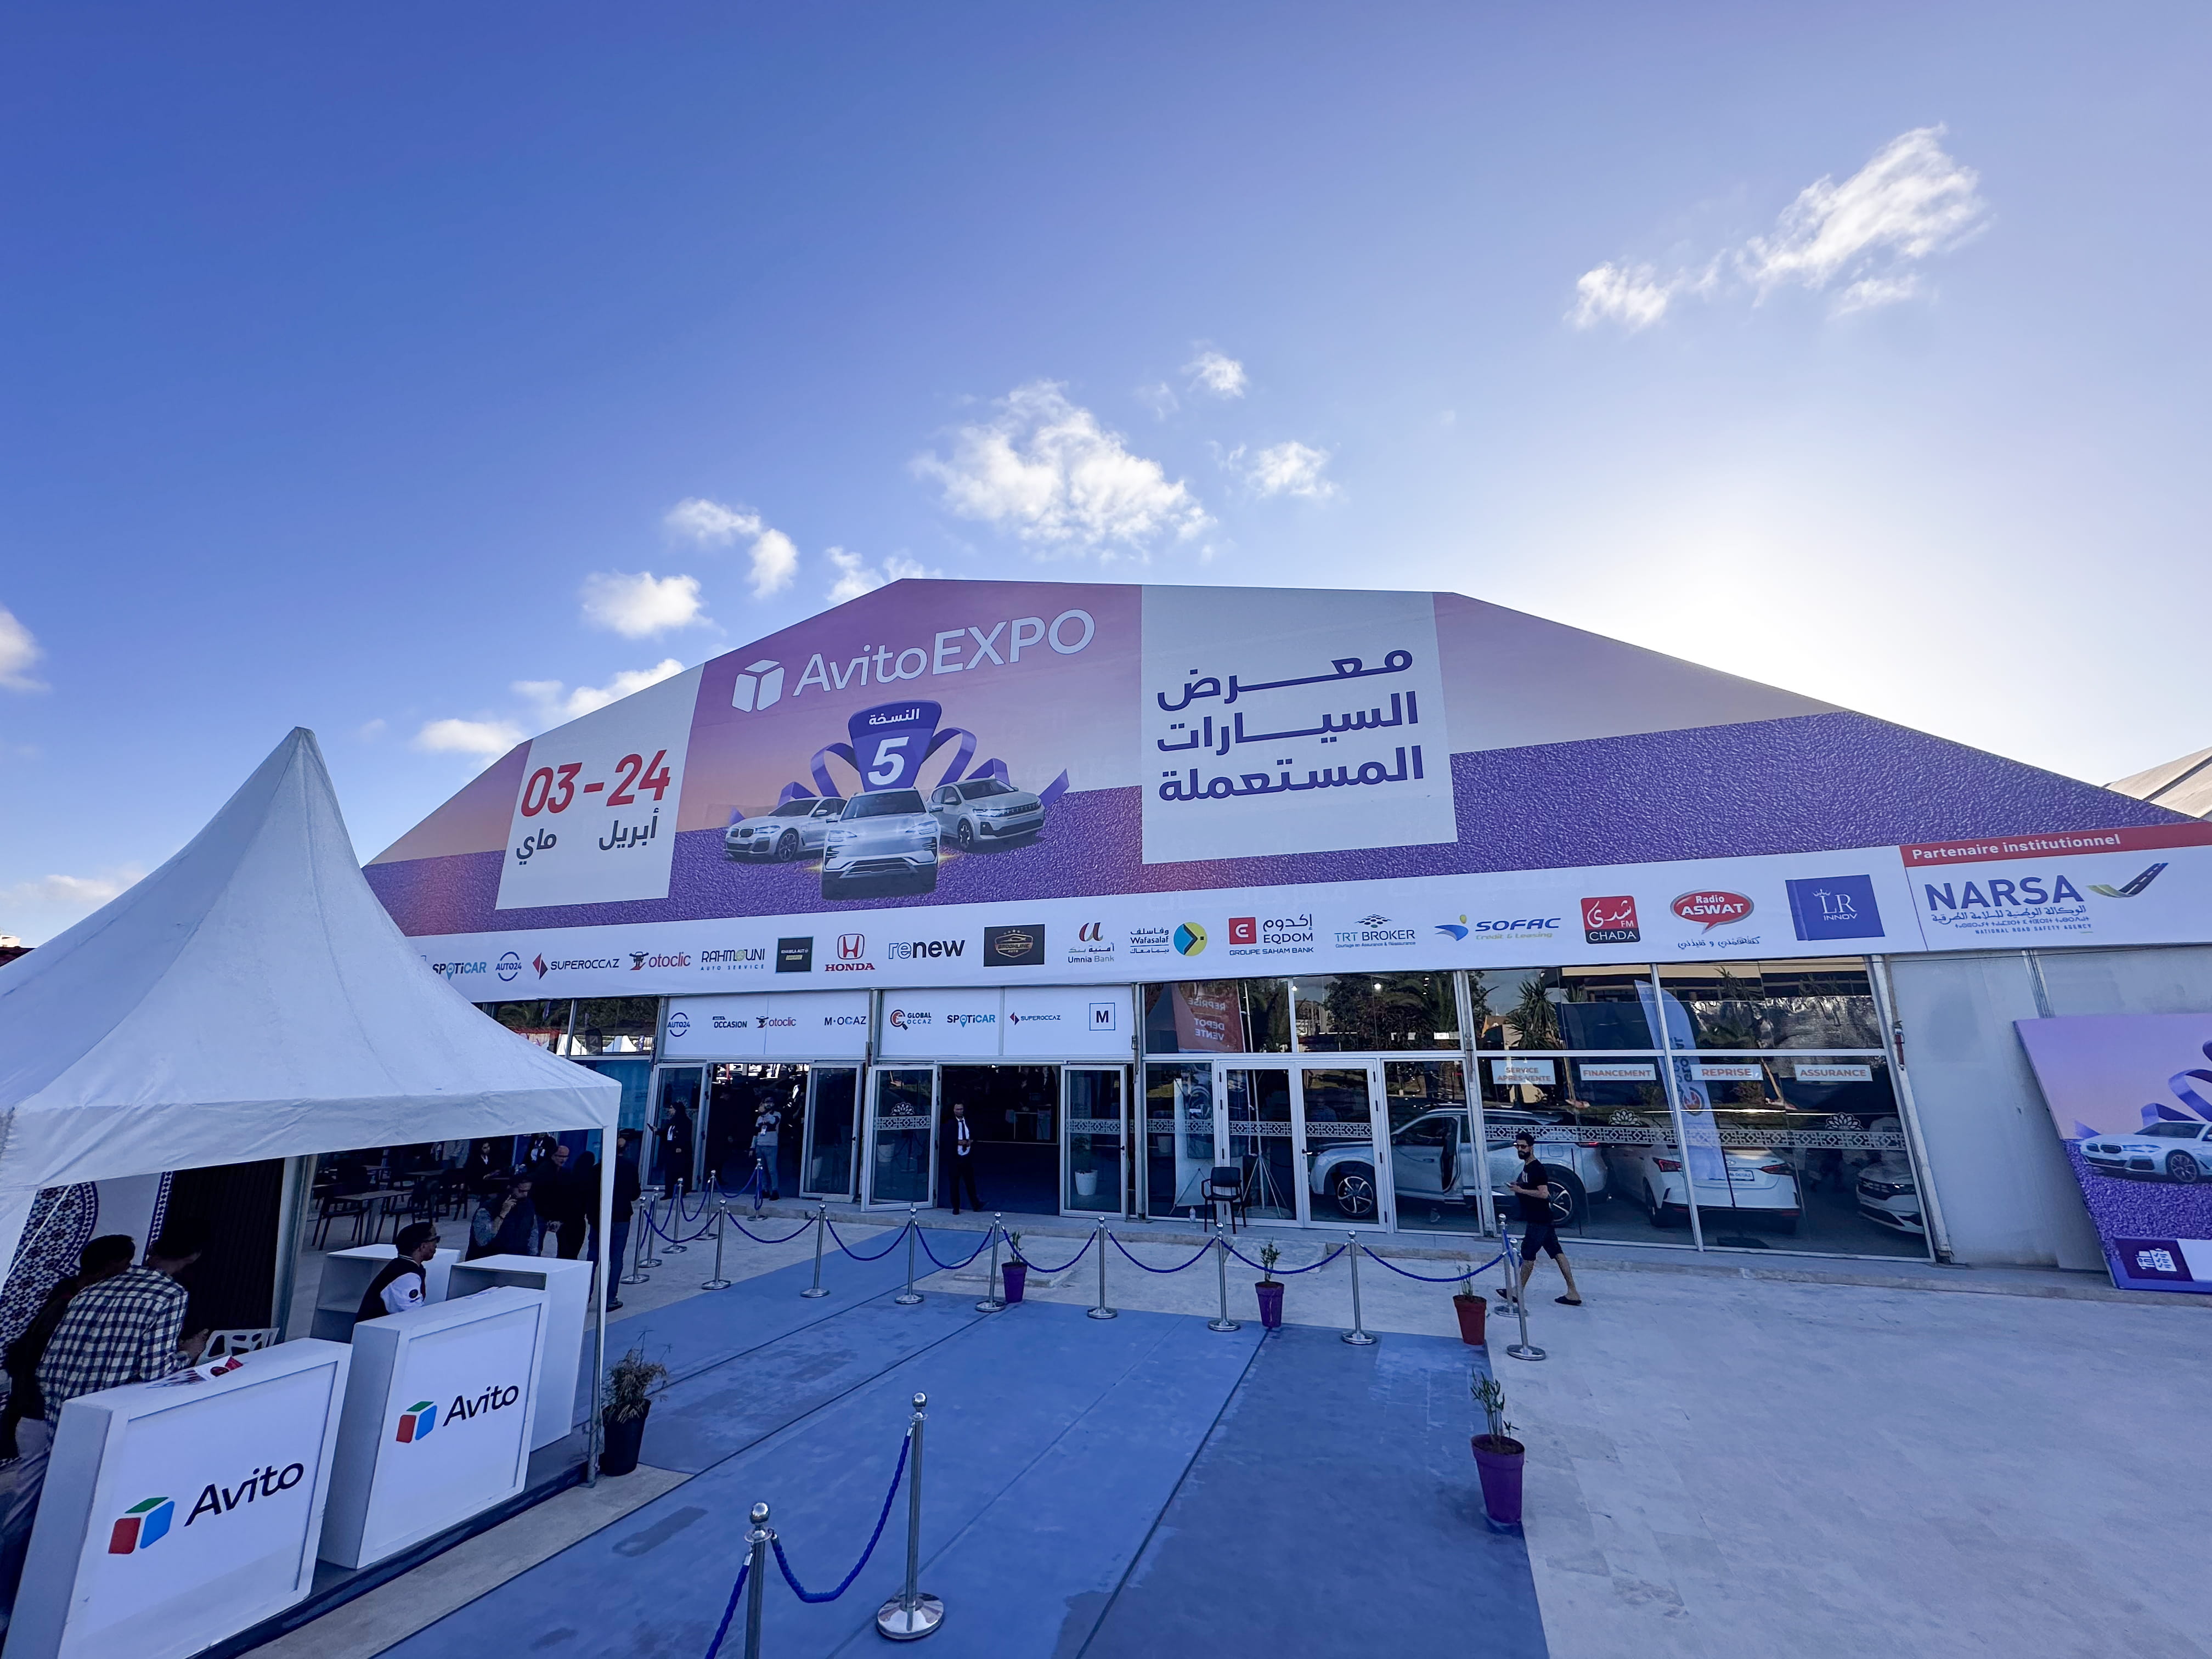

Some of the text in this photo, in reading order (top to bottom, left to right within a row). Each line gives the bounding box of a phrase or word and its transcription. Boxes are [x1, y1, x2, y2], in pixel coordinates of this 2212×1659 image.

[792, 608, 1096, 697] AvitoEXPO
[1157, 650, 1413, 712] معرض
[868, 708, 920, 725] النسخة
[1157, 691, 1419, 755] السيارات
[868, 736, 910, 785] 5
[1158, 745, 1424, 801] المستعملة
[516, 808, 659, 865] أبريل ماي
[1912, 834, 2120, 860] Partenaire institutionnel
[1695, 895, 1725, 903] Radio
[1925, 875, 2085, 911] NARSA
[1681, 903, 1744, 916] ASWAT
[2045, 905, 2086, 917] الوكالة
[1475, 917, 1561, 932] SOFAC
[1130, 936, 1169, 944] Wafasalaf
[1263, 933, 1313, 945] EQDOM
[1334, 929, 1415, 942] TRT BROKER
[1589, 930, 1637, 941] CHADA
[888, 940, 966, 960] renew
[551, 958, 620, 970] SUPEROCCAZ
[649, 951, 691, 968] otoclic
[825, 962, 876, 972] HONDA
[769, 1017, 797, 1027] otoclic
[1096, 1011, 1109, 1023] M
[1701, 1068, 1752, 1076] REPRISE
[442, 1385, 520, 1427] Avito
[184, 1462, 304, 1527] Avito
